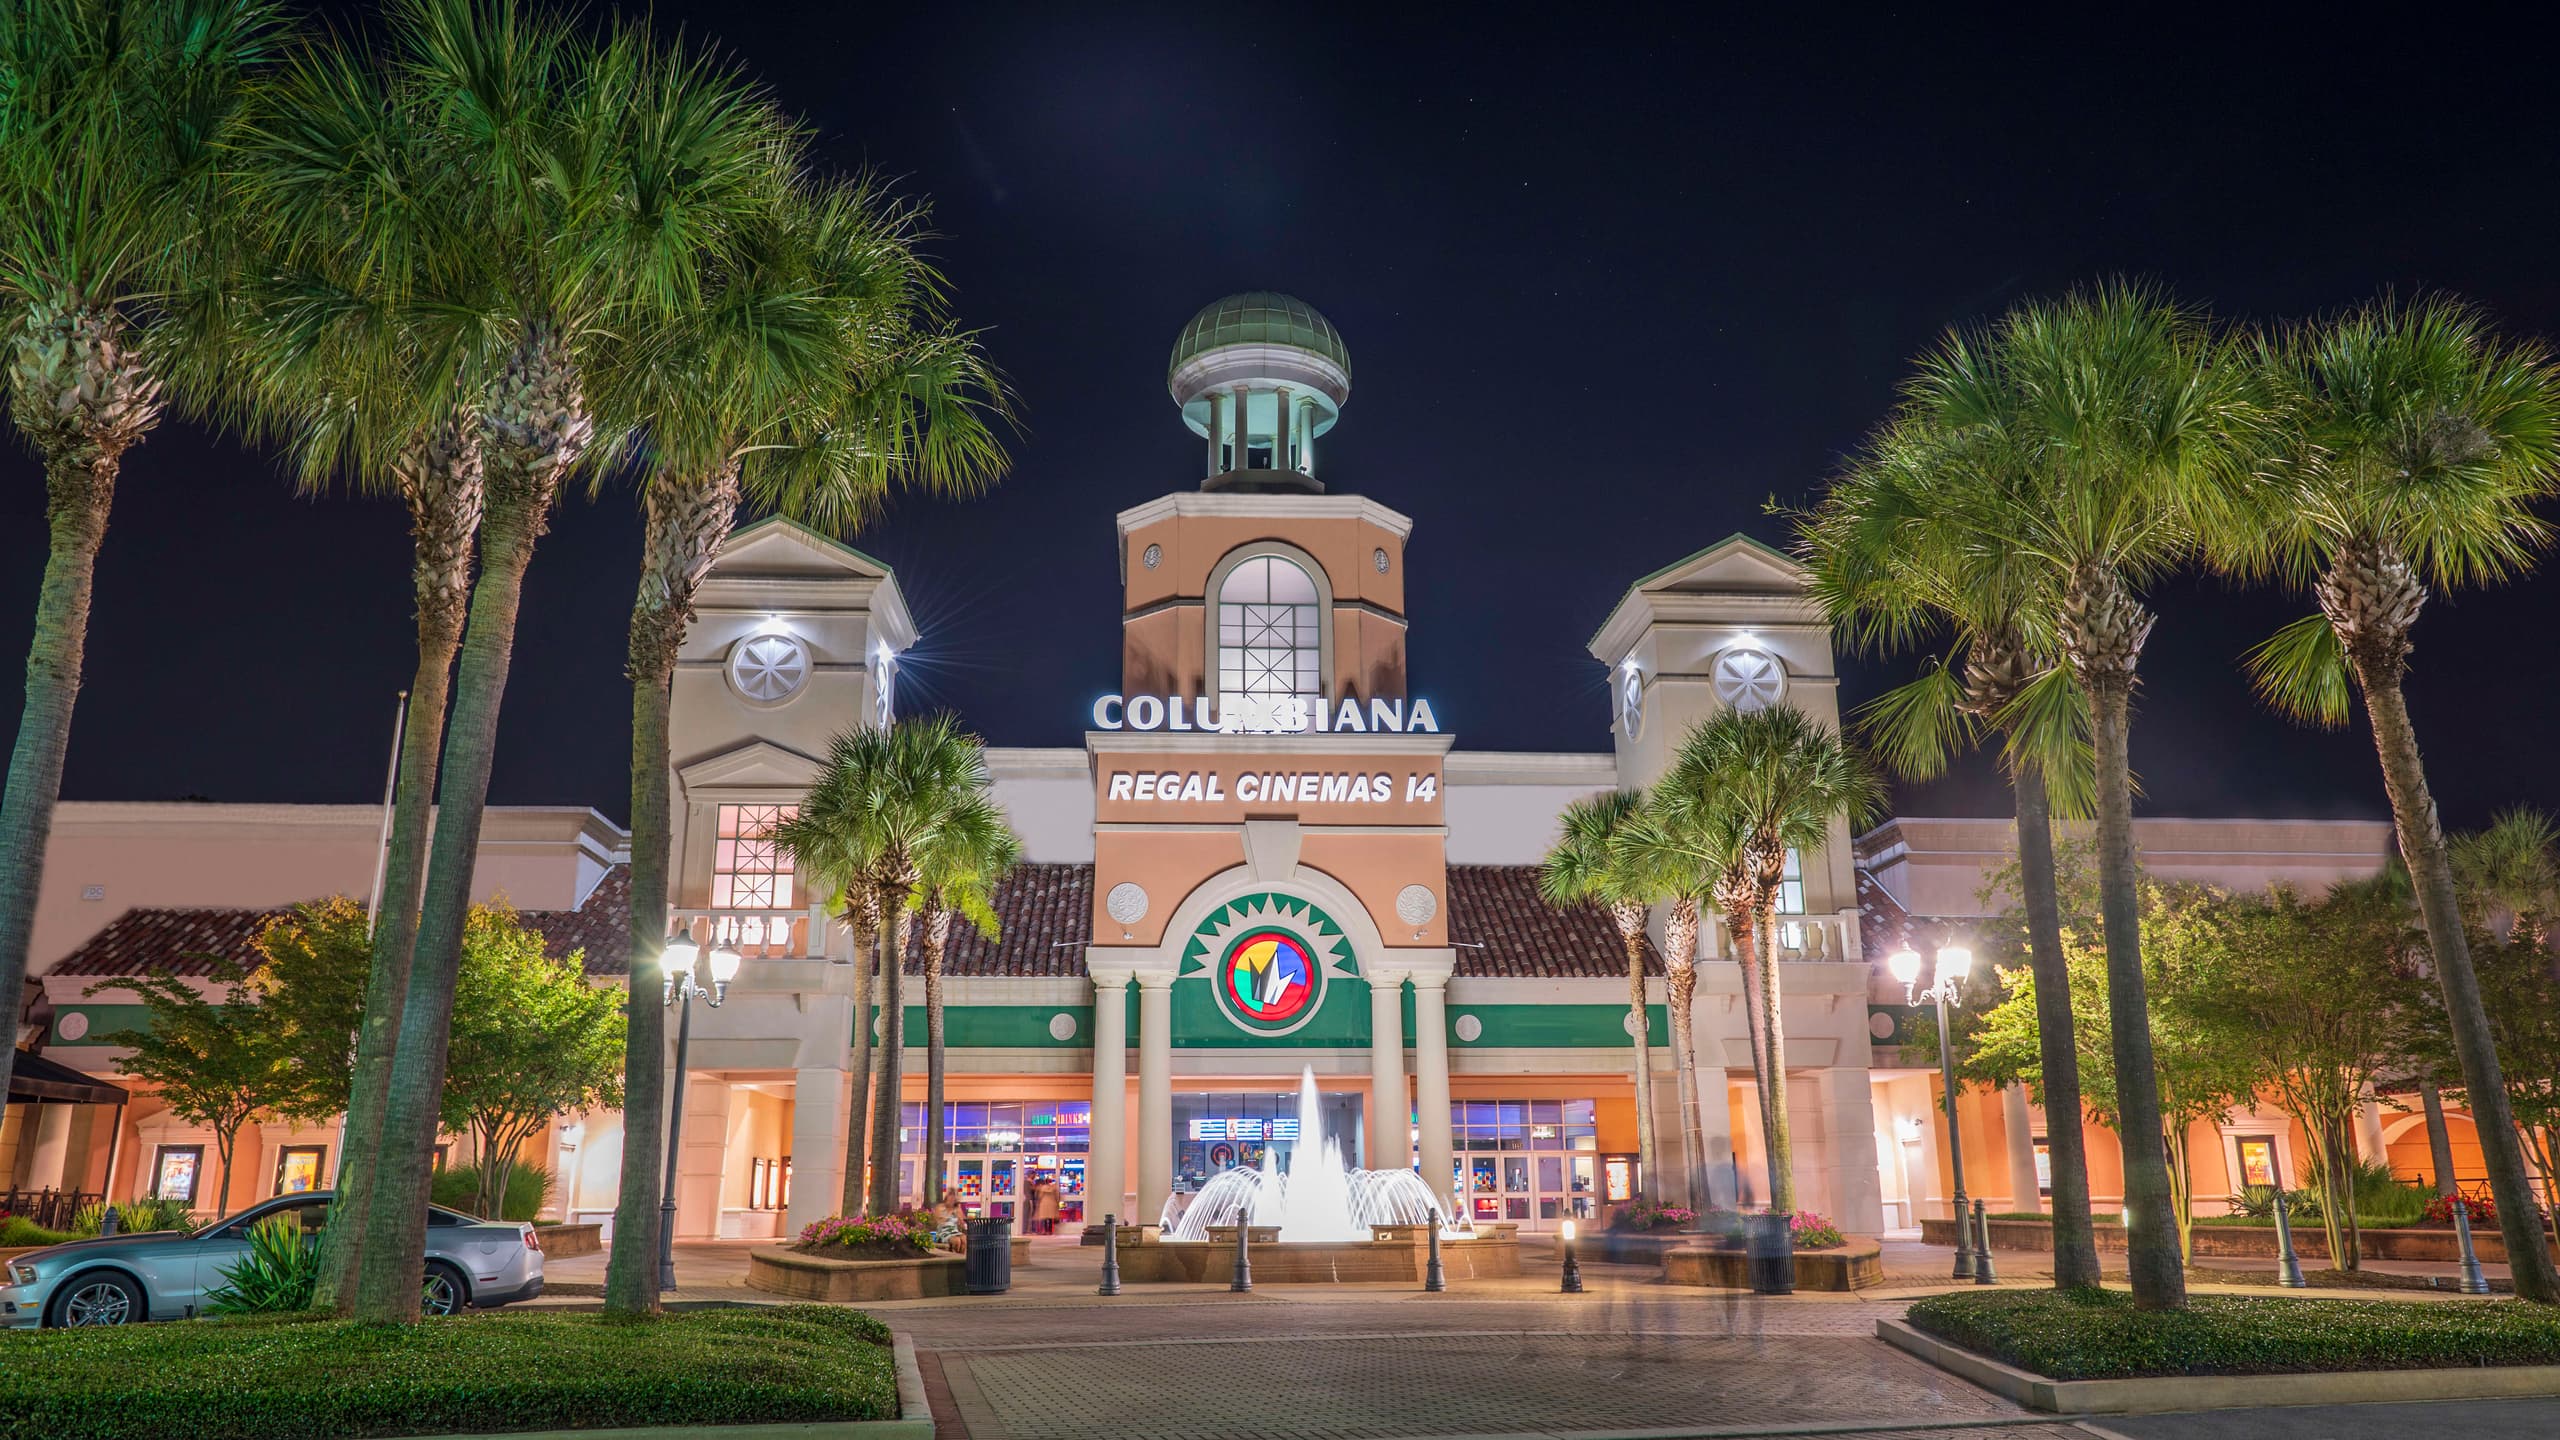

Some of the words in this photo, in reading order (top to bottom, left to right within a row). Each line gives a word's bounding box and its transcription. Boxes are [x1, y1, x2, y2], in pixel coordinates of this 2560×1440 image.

[1108, 774, 1224, 801] REGAL
[1236, 774, 1392, 802] CINEMAS
[1405, 776, 1437, 802] 14
